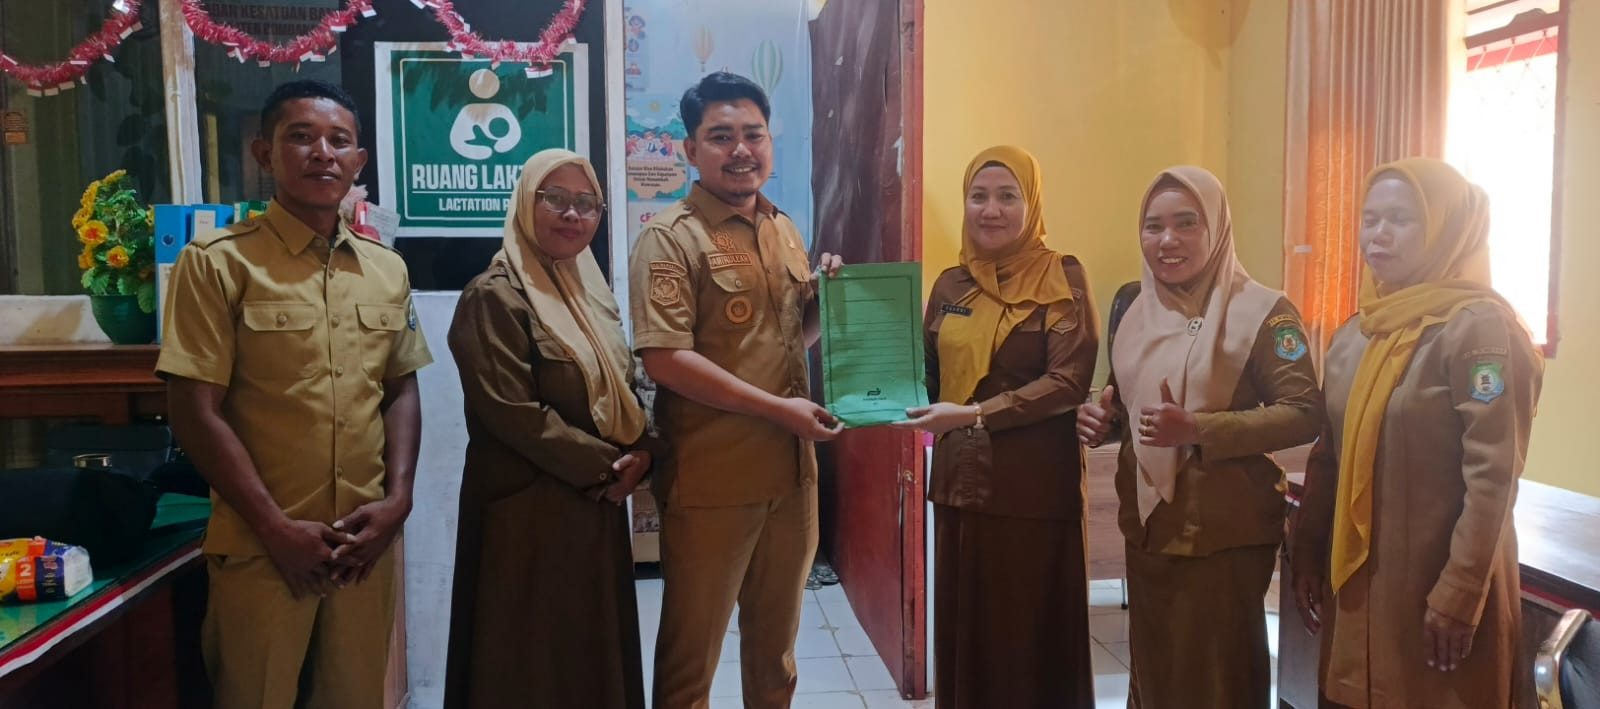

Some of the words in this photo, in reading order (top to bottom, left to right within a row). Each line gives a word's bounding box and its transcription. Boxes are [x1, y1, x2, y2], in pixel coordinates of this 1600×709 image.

[411, 164, 478, 190] RUANG
[481, 164, 523, 190] LAK
[439, 198, 501, 212] LACTATION
[20, 563, 32, 577] 2
